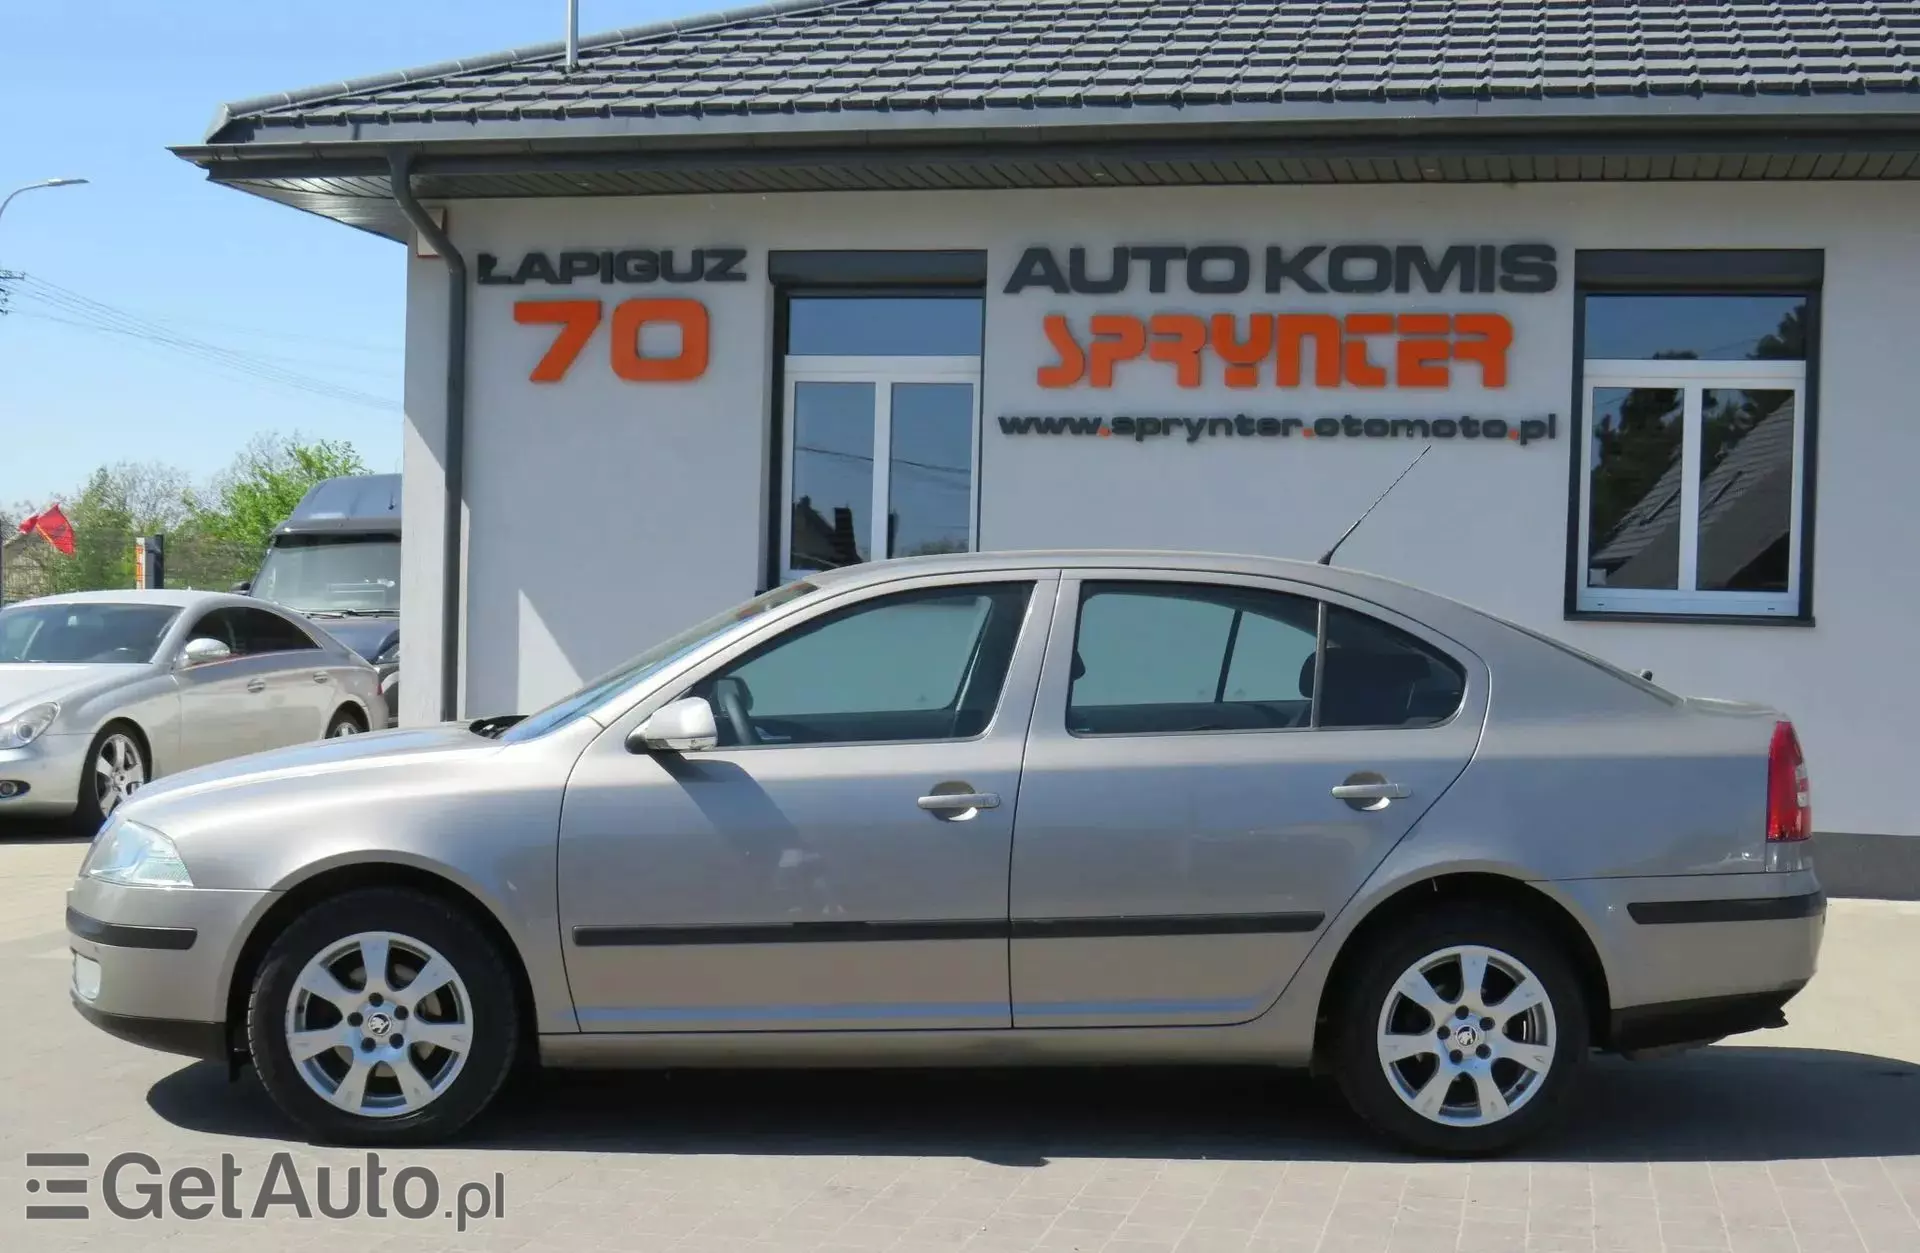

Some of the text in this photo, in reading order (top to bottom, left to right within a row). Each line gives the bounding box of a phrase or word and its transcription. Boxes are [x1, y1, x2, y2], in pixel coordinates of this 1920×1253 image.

[1003, 244, 1558, 294] AUTO KOMIS
[513, 298, 710, 382] 70
[1037, 313, 1514, 388] SPRYNTER
[998, 413, 1556, 446] www.sprynter.otomoto.pl
